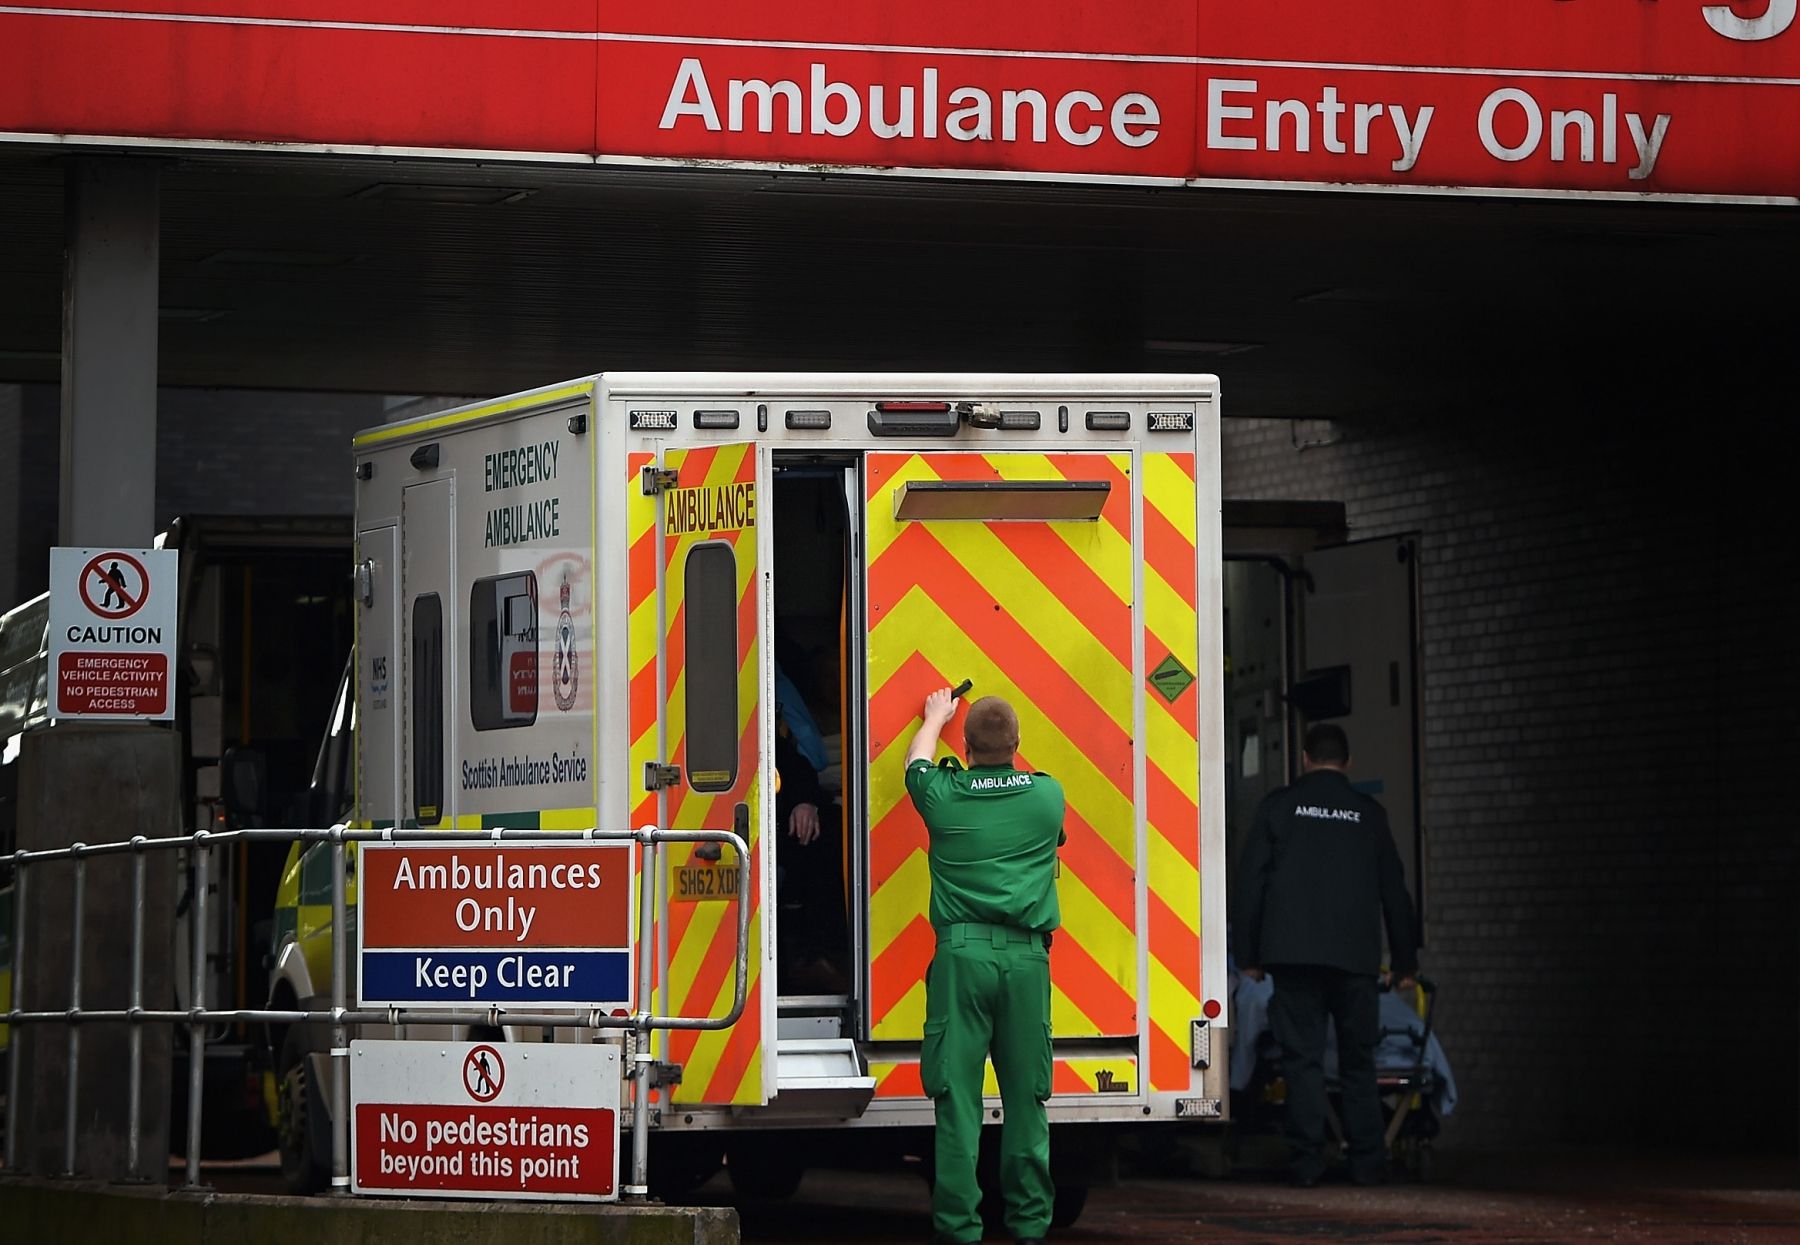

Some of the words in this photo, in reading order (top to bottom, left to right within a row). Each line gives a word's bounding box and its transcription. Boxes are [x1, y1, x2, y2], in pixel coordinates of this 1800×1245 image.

[659, 57, 1161, 149] Ambulance
[1206, 78, 1434, 172] Entry
[1478, 88, 1671, 180] Only
[485, 440, 560, 493] EMERGENCY
[484, 498, 560, 549] AMBULANCE
[666, 482, 755, 535] AMBULANCE
[66, 625, 162, 644] CAUTION
[62, 670, 110, 681] VEHICLE
[112, 671, 164, 681] ACTIVITY
[77, 658, 150, 669] EMERGENCY
[372, 656, 387, 681] NHS
[66, 686, 84, 696] NO
[86, 686, 158, 697] PEDESTRIAN
[88, 699, 135, 709] ACCESS
[462, 757, 498, 791] Scottish
[500, 754, 550, 788] Ambulance
[552, 751, 587, 784] Service
[970, 774, 1032, 790] AMBULANCE
[1295, 804, 1361, 823] AMBULANCE
[394, 856, 602, 890] Ambulances
[679, 868, 714, 895] SH62
[455, 896, 536, 941] Only
[415, 957, 488, 997] Keep
[496, 956, 575, 989] Clear
[380, 1112, 417, 1144] No
[426, 1116, 589, 1151] pedestrians
[380, 1150, 463, 1182] beyond
[470, 1152, 513, 1178] this
[520, 1154, 579, 1183] point
